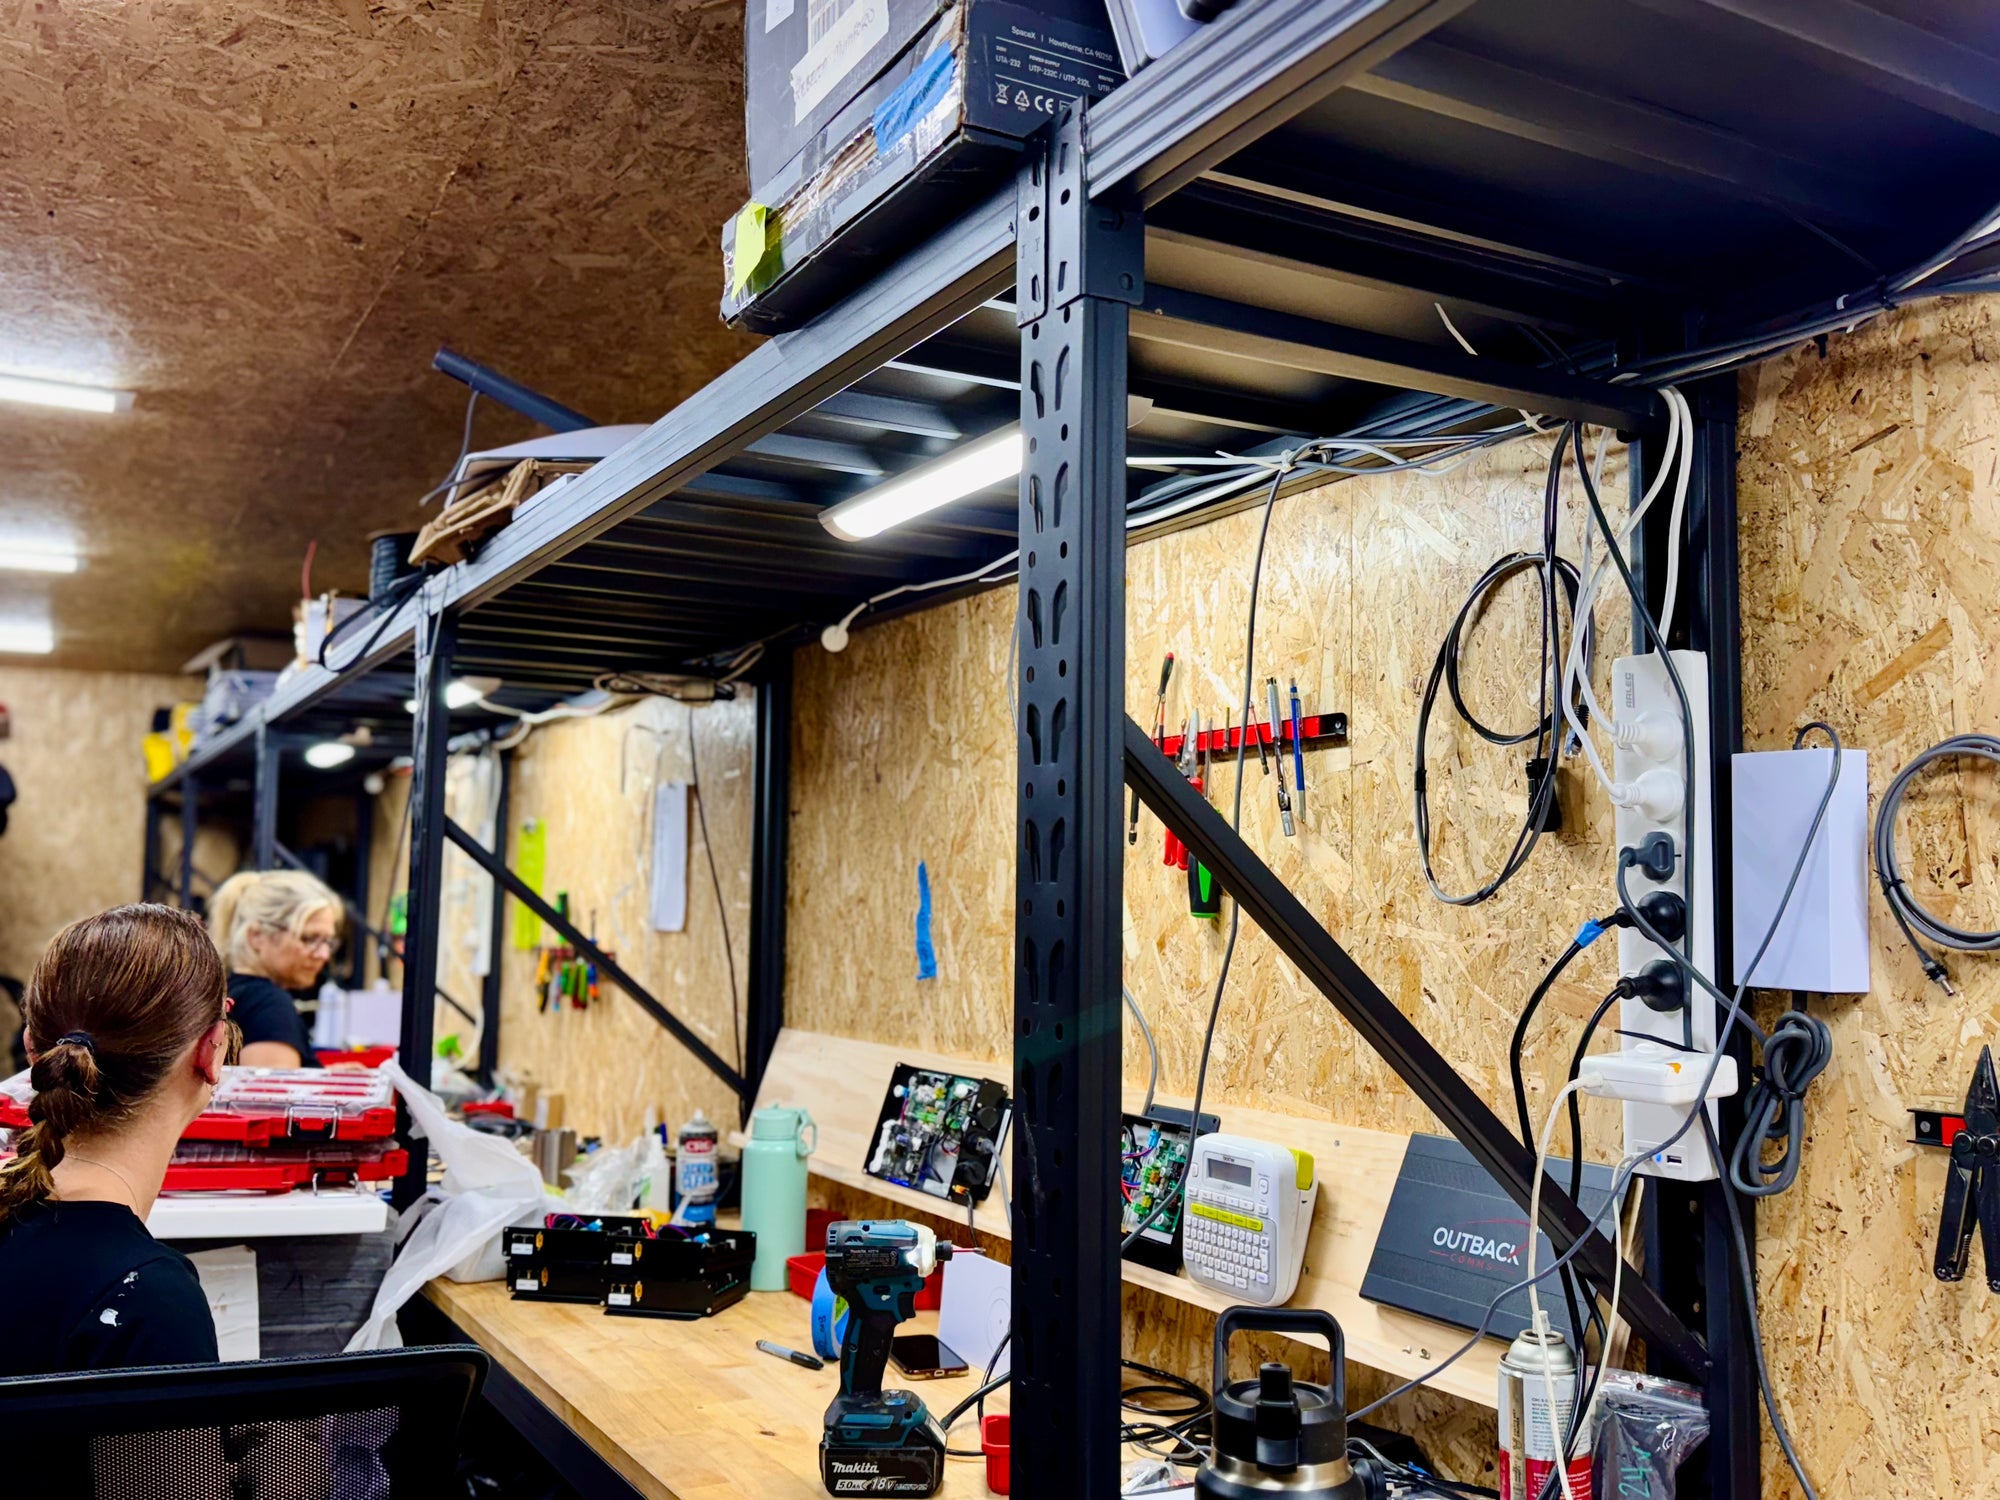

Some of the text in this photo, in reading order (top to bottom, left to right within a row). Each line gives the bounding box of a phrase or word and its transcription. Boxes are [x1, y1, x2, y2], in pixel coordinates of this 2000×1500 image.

[1011, 26, 1037, 40] SpaceX
[1084, 48, 1094, 57] CA
[995, 55, 1021, 68] UTA-232
[1433, 1226, 1519, 1266] OUTBACK
[1450, 1253, 1493, 1271] COMMS
